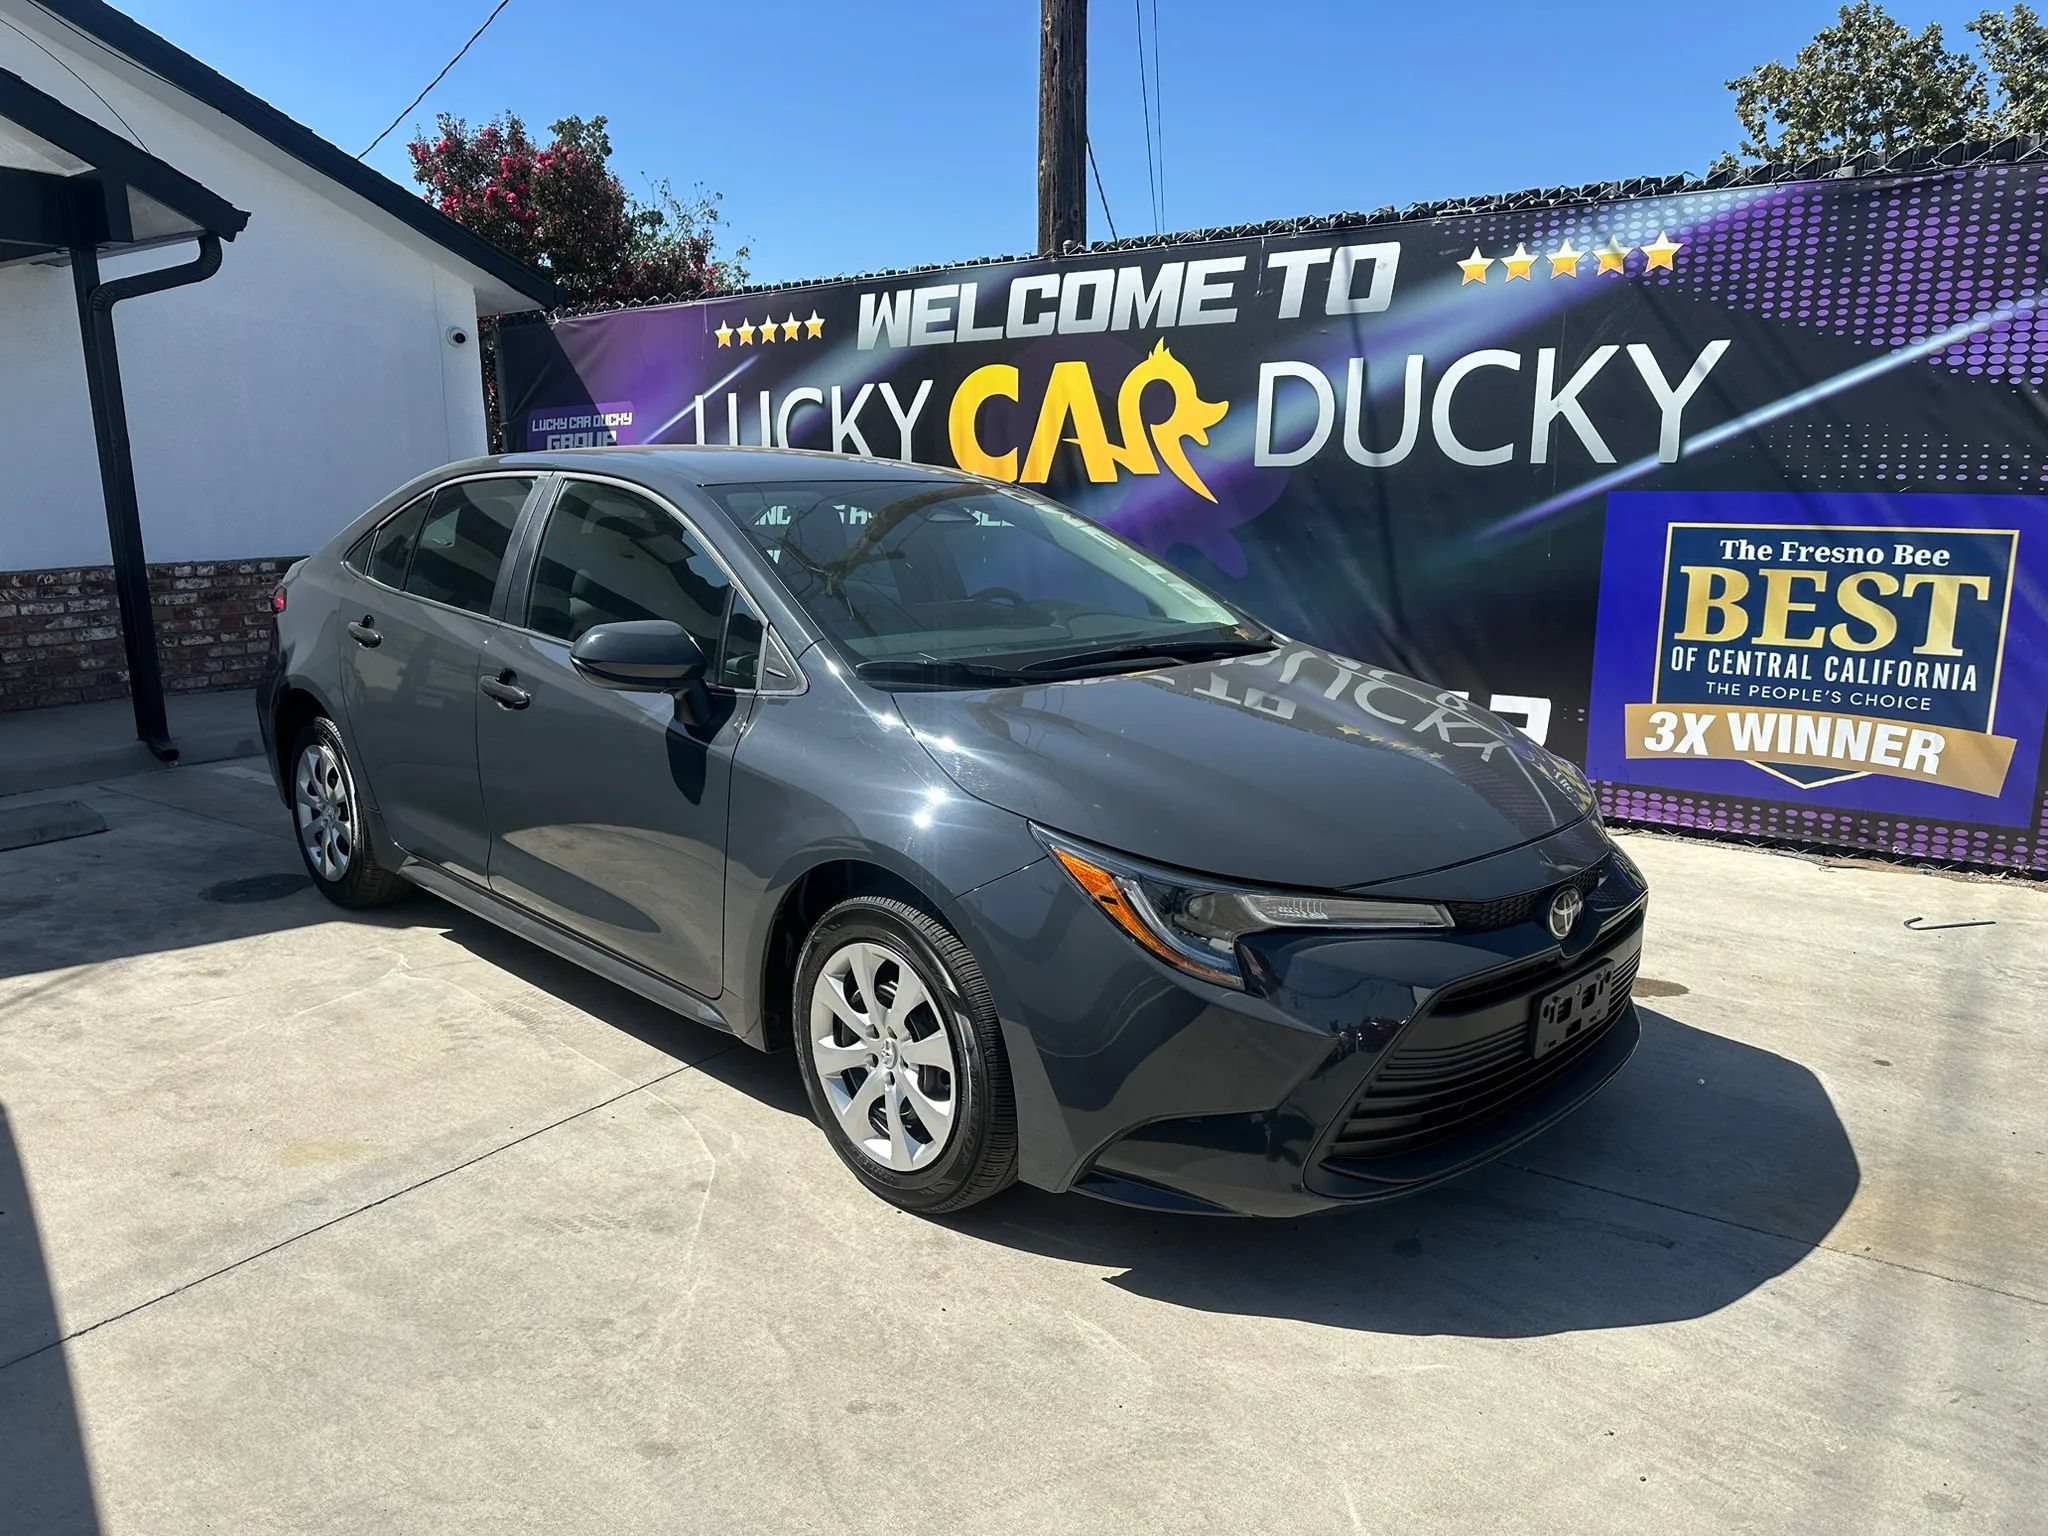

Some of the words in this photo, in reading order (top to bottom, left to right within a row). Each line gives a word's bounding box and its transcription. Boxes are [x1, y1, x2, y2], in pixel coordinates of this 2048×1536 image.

[857, 256, 1247, 350] WELCOME
[1267, 241, 1401, 319] TO
[532, 417, 568, 432] LUCKY
[569, 415, 592, 429] CAR
[593, 412, 633, 427] DUCKY
[948, 337, 1230, 504] CAR
[1254, 339, 1731, 467] DUCKY
[1720, 539, 1772, 561] The
[1780, 541, 1885, 564] Fresno
[1892, 545, 1950, 566] Bee
[1674, 565, 1990, 656] BEST
[1671, 646, 1698, 671] OF
[1708, 648, 1812, 680] CENTRAL
[1824, 655, 1978, 691] CALIFORNIA
[1706, 682, 1740, 696] THE
[1749, 685, 1842, 704] PEOPLE'S
[1850, 692, 1931, 711] CHOICE
[1644, 711, 1717, 756] 3X
[1727, 711, 1946, 776] WINNER
